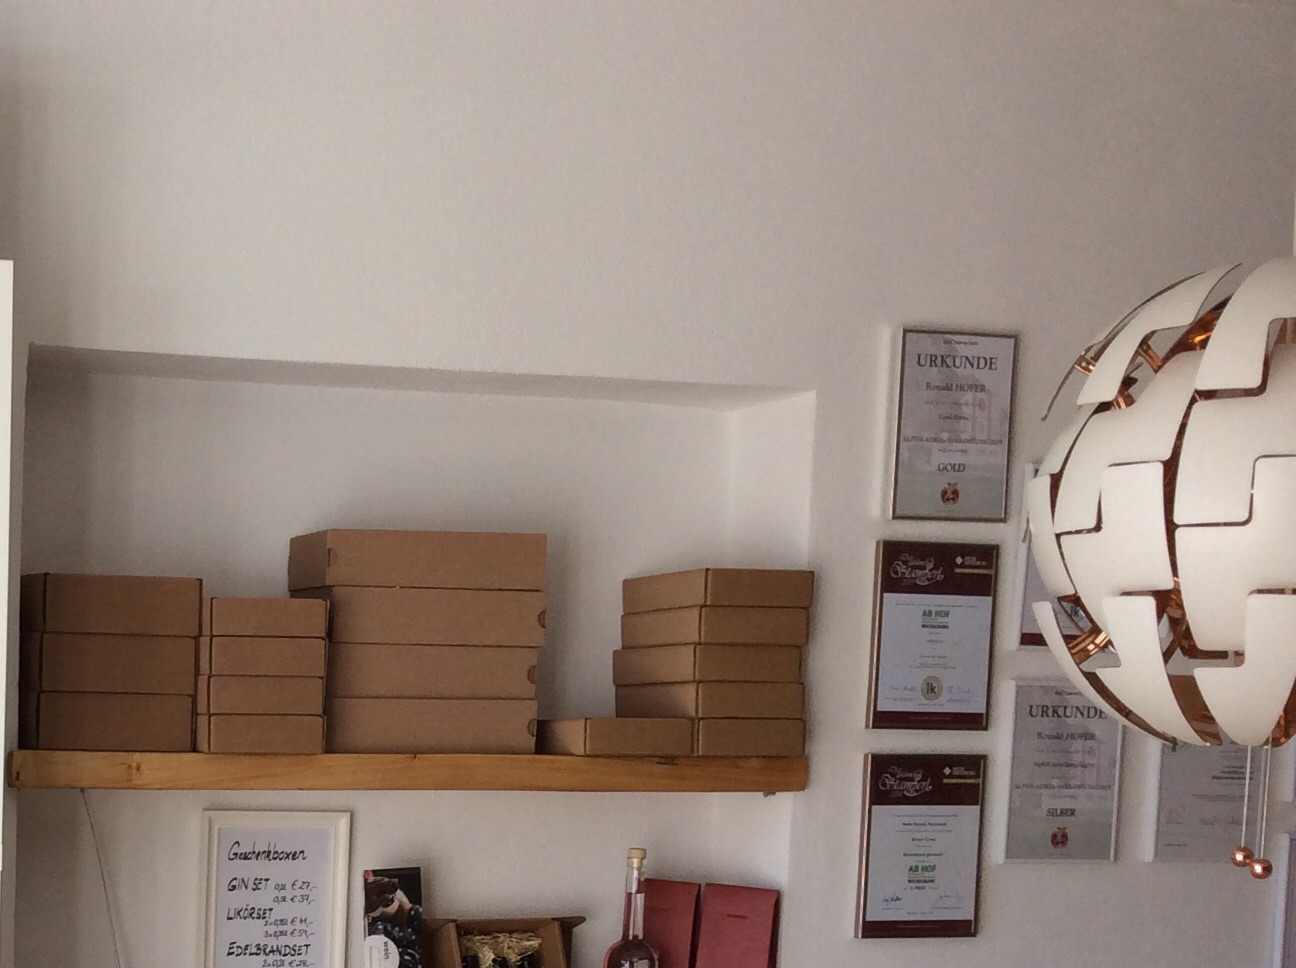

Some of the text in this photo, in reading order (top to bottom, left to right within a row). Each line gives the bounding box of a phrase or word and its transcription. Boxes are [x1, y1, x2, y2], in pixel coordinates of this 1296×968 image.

[917, 353, 998, 371] URKUNDE
[955, 383, 986, 393] HOFER
[937, 462, 966, 473] GOLD
[228, 840, 308, 862] Geschenkboxen
[227, 877, 250, 892] GIN
[251, 877, 271, 892] SET
[226, 941, 311, 958] EDELBRANDSET
